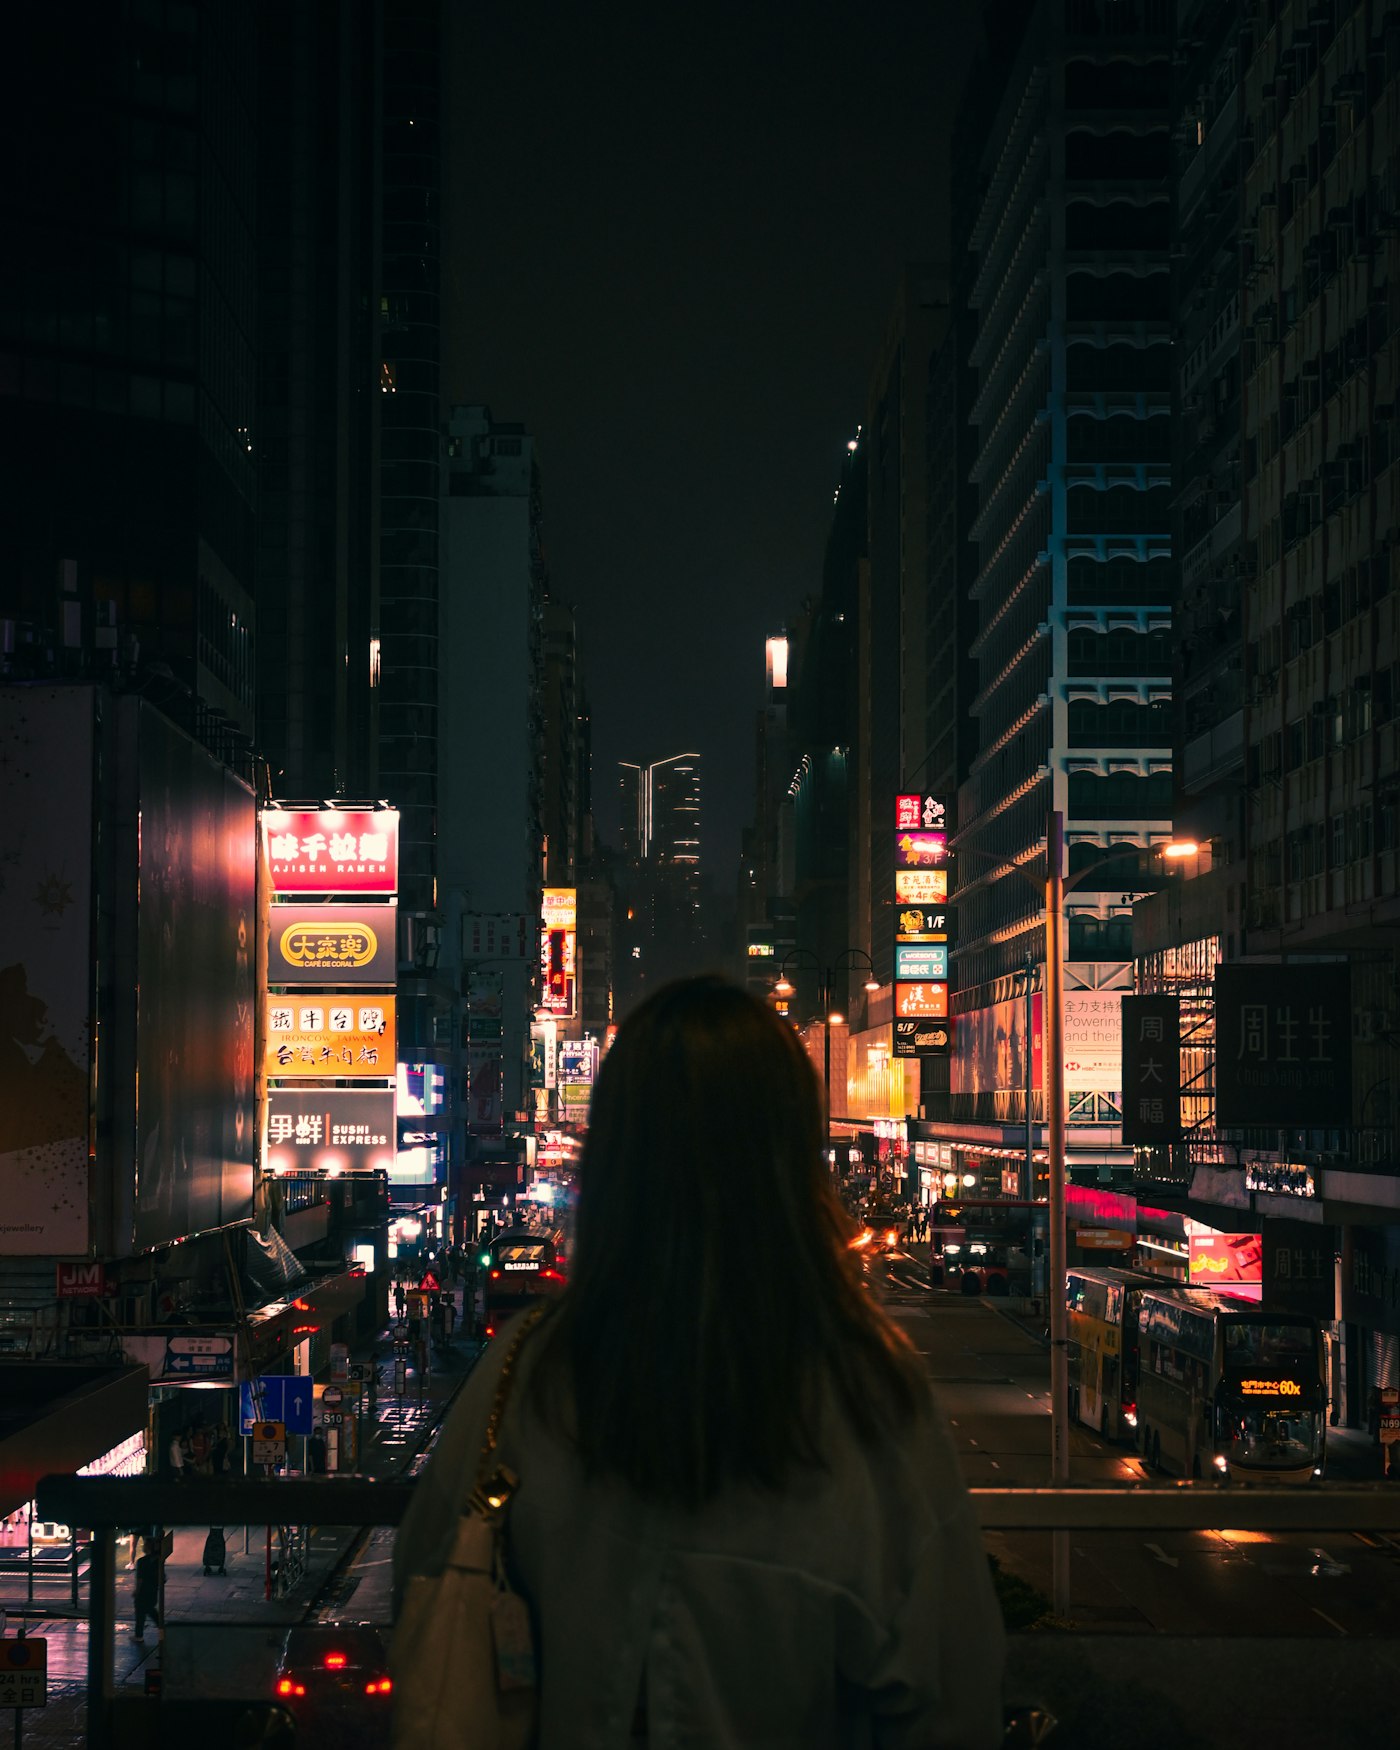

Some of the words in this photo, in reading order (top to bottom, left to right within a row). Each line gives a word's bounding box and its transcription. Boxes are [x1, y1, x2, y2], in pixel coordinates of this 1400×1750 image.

[273, 864, 327, 873] AJISEN
[337, 864, 387, 873] RAMEN
[927, 915, 945, 928] 1/F
[1065, 1030, 1088, 1042] and
[1092, 1030, 1120, 1042] their
[1237, 1004, 1333, 1062] 周生生
[1139, 1017, 1164, 1125] 周大福
[332, 1125, 369, 1134] SUSHI
[332, 1135, 387, 1144] EXPRESS
[1273, 1248, 1324, 1279] 周生生
[63, 1264, 100, 1285] JM
[62, 1286, 99, 1295] NETWORK
[323, 1414, 343, 1424] S10
[273, 1443, 279, 1451] 7
[274, 1455, 283, 1463] 12
[0, 1675, 15, 1685] 24
[21, 1674, 40, 1685] hrs
[2, 1688, 34, 1703] 全日
